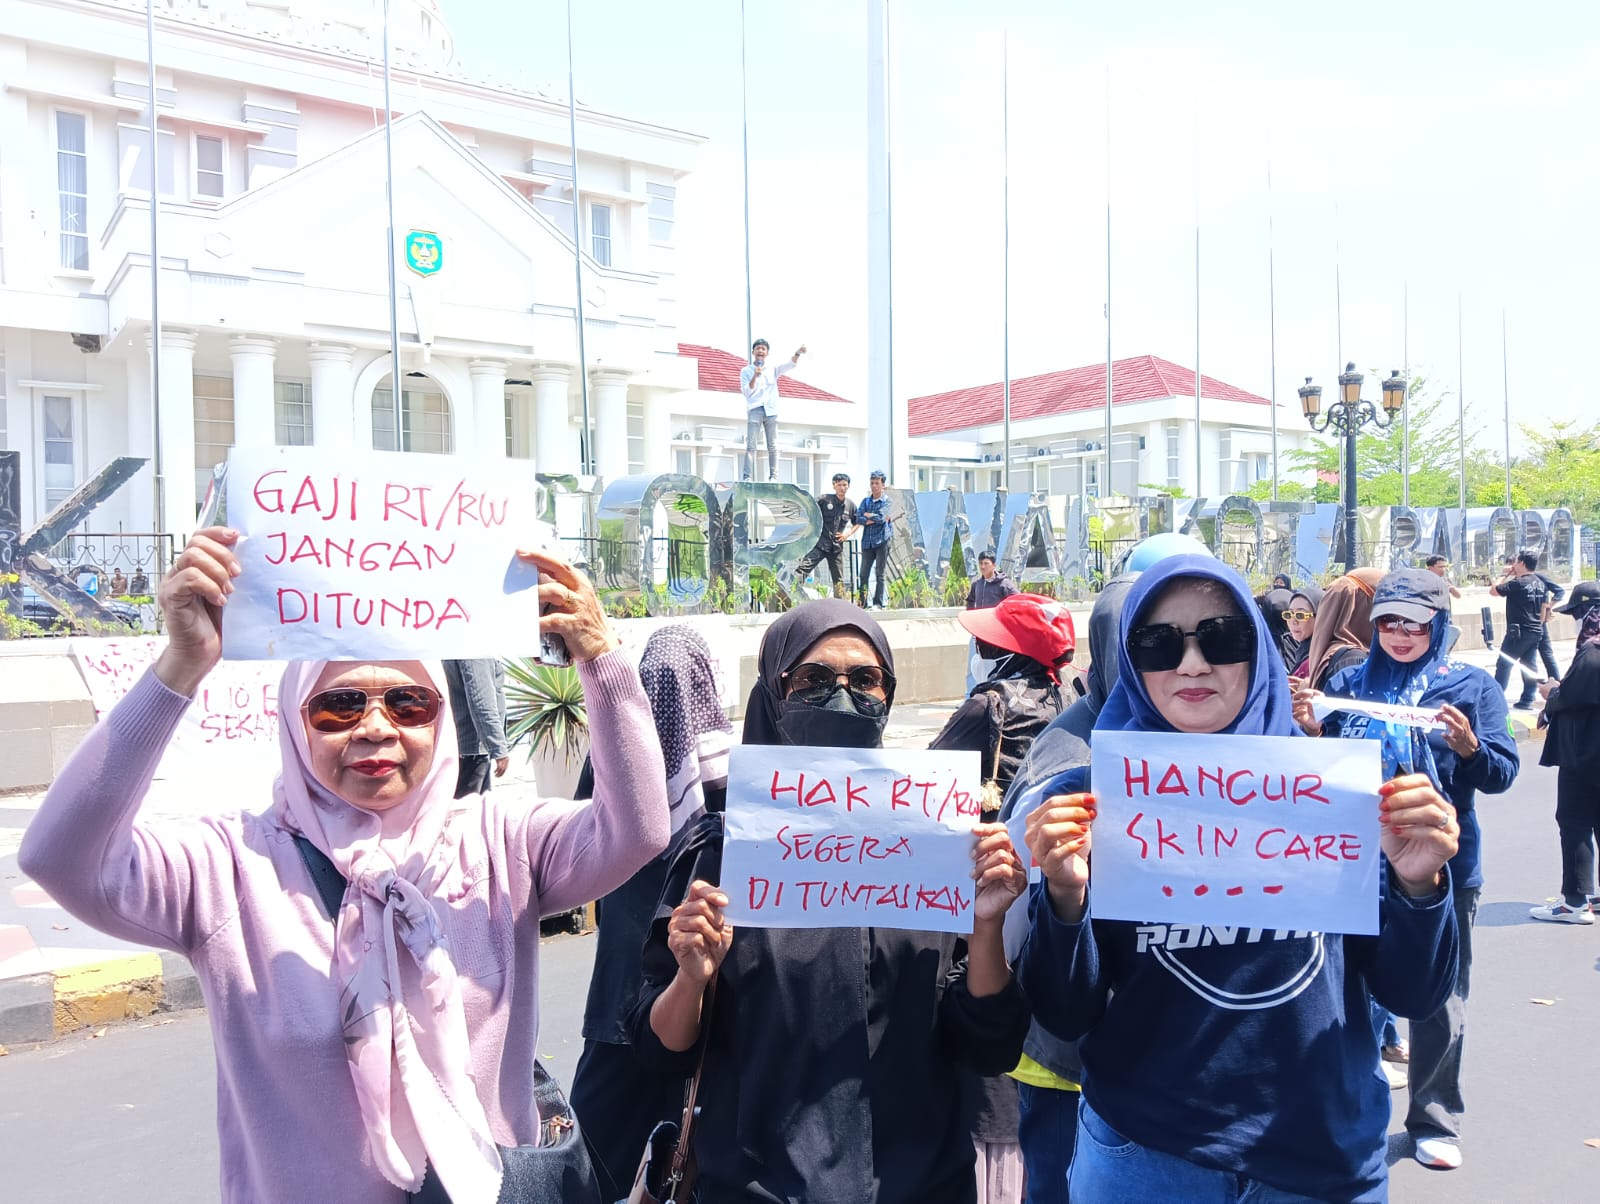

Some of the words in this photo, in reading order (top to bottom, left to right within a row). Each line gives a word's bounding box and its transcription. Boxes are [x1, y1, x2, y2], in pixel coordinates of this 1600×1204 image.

[253, 470, 358, 521] GAJI
[383, 478, 508, 531] RT/RW
[265, 532, 455, 571] JANGAN
[277, 588, 471, 630] DITUNDA
[771, 770, 871, 811] HAK
[1124, 757, 1330, 805] HANCUR
[776, 826, 912, 864] SEGERA
[1127, 812, 1238, 860] SKIN
[1255, 828, 1362, 861] CARE
